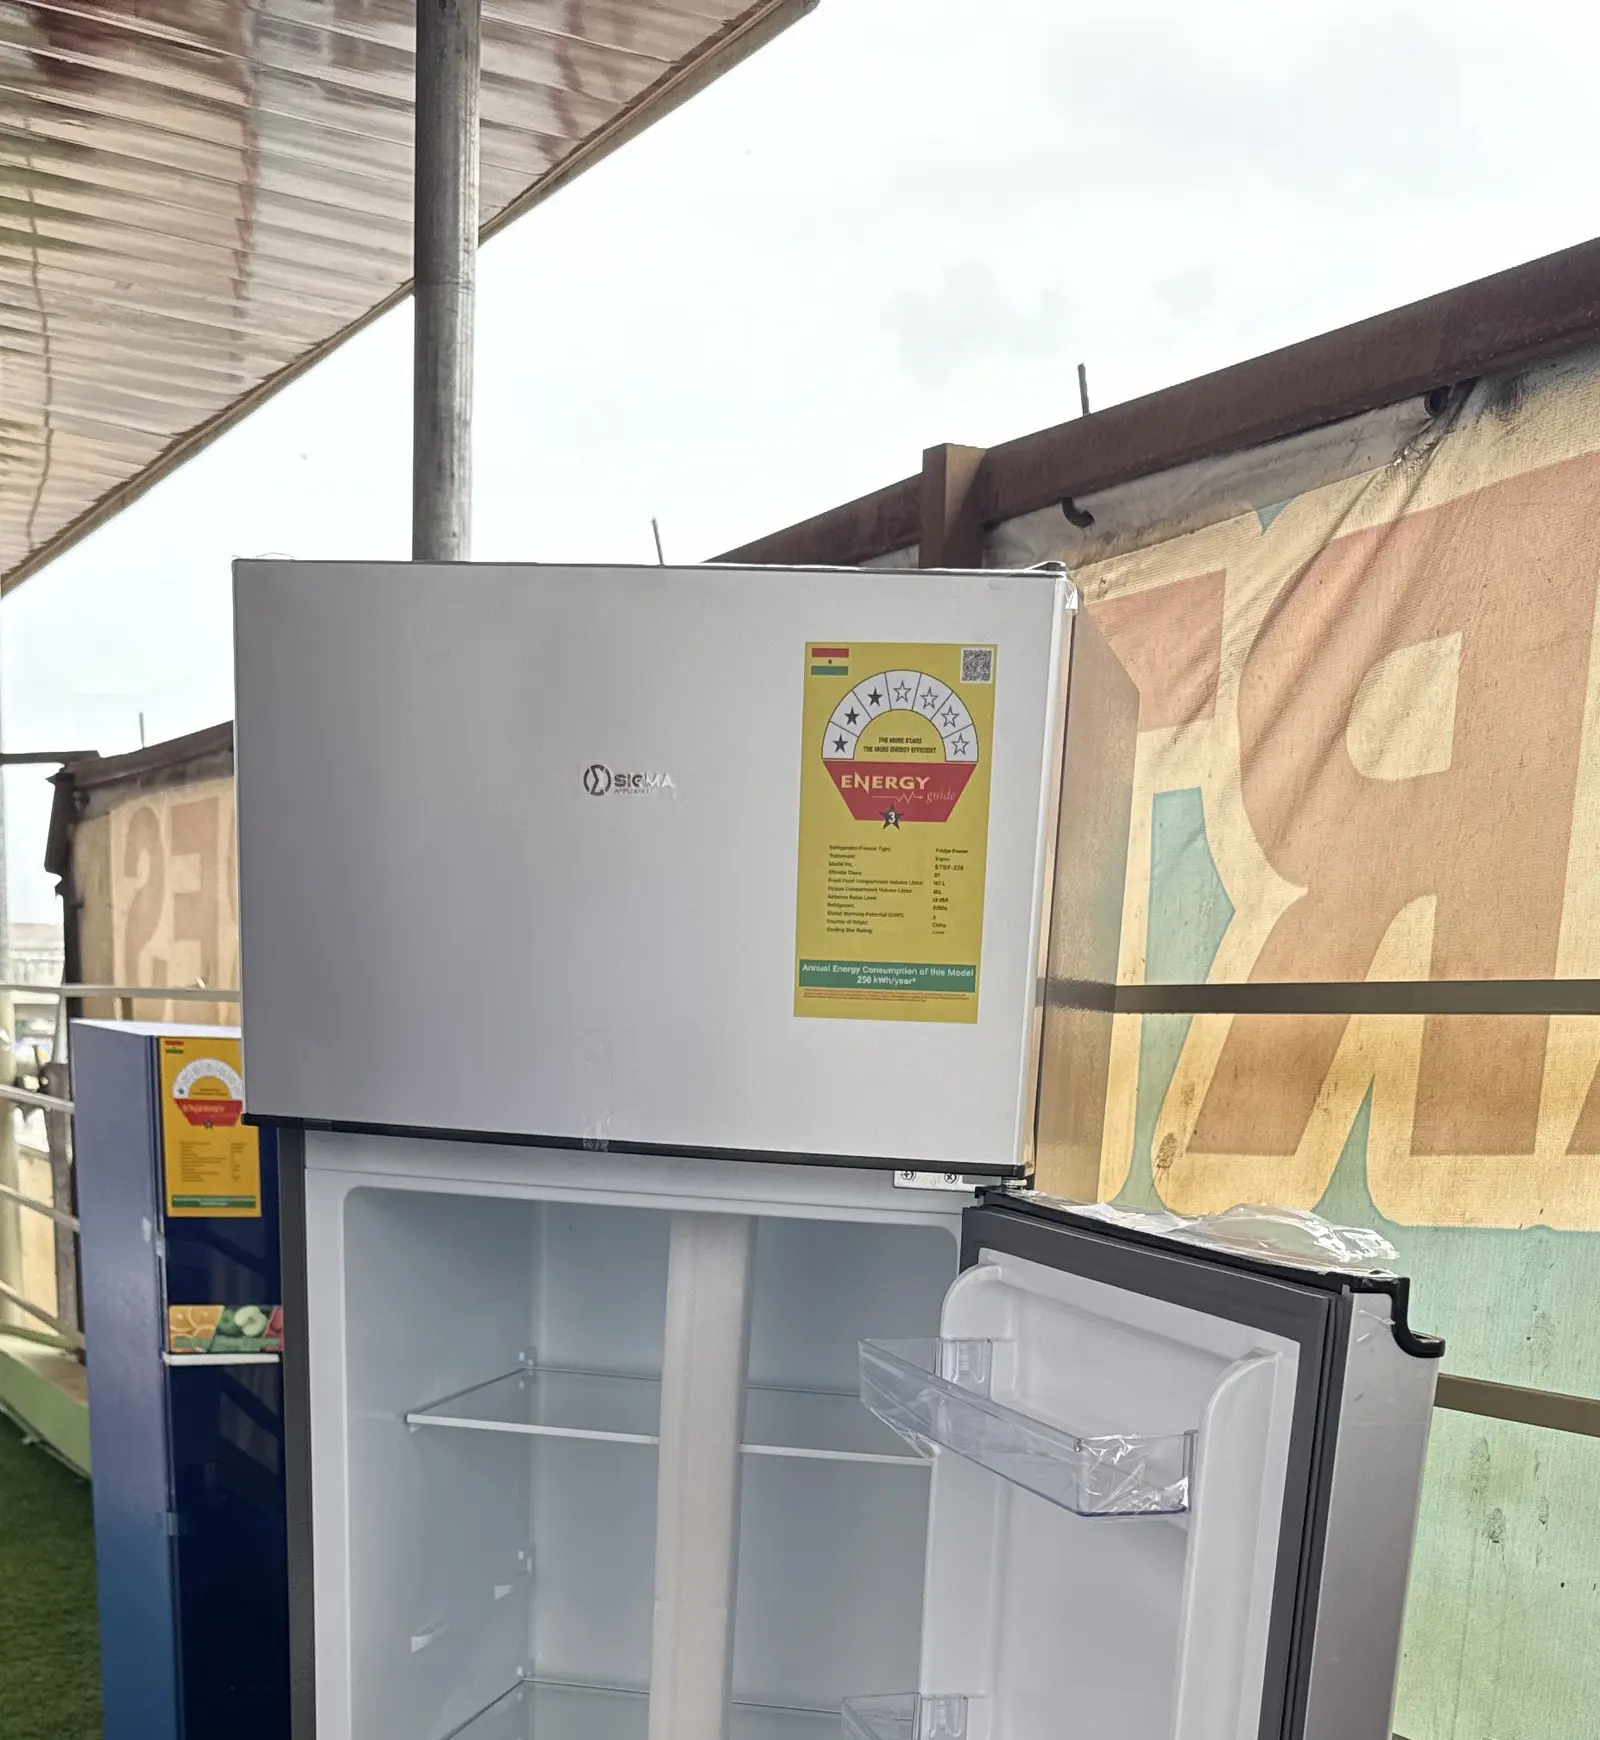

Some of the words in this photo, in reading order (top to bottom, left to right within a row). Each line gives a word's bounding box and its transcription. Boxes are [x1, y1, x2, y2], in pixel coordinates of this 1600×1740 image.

[614, 771, 674, 788] SIGMA
[841, 771, 930, 795] ENERGY
[888, 811, 896, 823] 3
[802, 963, 831, 973] Annual
[832, 964, 861, 975] Energy
[862, 965, 917, 976] Consumption
[919, 967, 928, 976] of
[930, 967, 945, 977] this
[947, 967, 974, 977] Model
